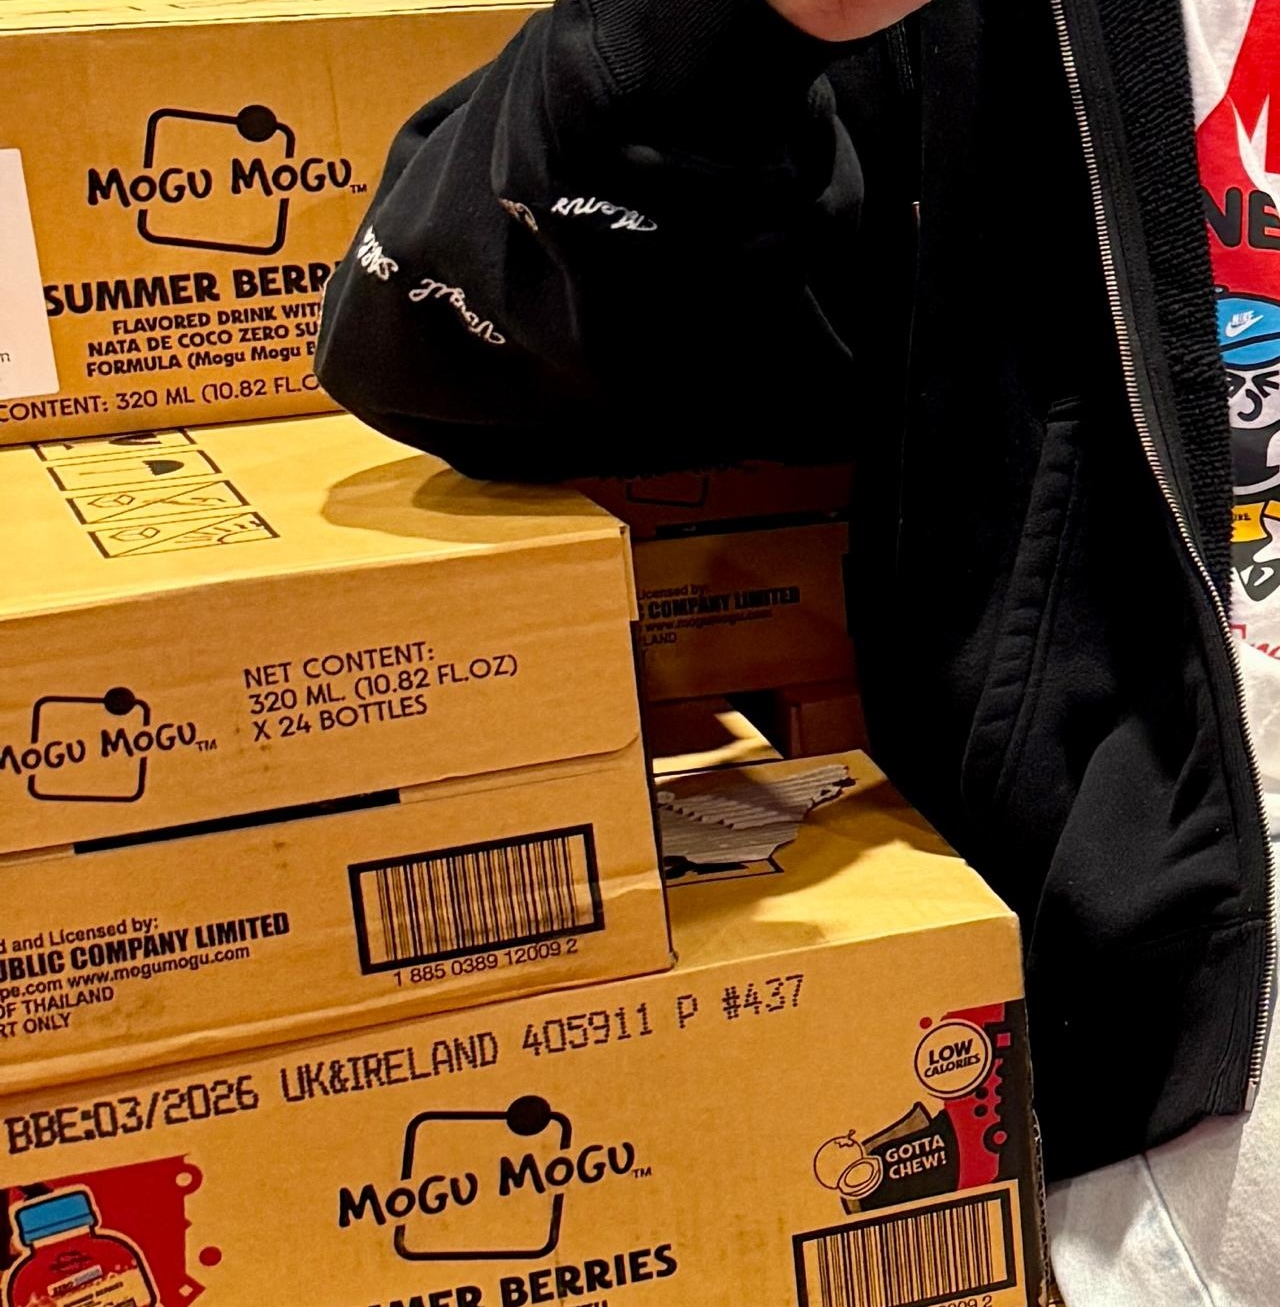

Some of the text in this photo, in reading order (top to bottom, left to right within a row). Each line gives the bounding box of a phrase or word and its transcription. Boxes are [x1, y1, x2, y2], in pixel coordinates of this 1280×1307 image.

[44, 272, 220, 317] SUMMER
[112, 307, 277, 335] FLAVORED DRINK
[242, 642, 434, 689] NET CONTENT:
[70, 911, 290, 970] COMPANY LIMITED
[7, 974, 804, 1154] BBE:03/2026 UK&IRELAND 405911 P #437
[924, 1053, 981, 1079] CALORIES
[928, 1039, 973, 1065] LOW
[885, 1134, 945, 1163] GOTTA
[889, 1151, 947, 1180] CHEW!
